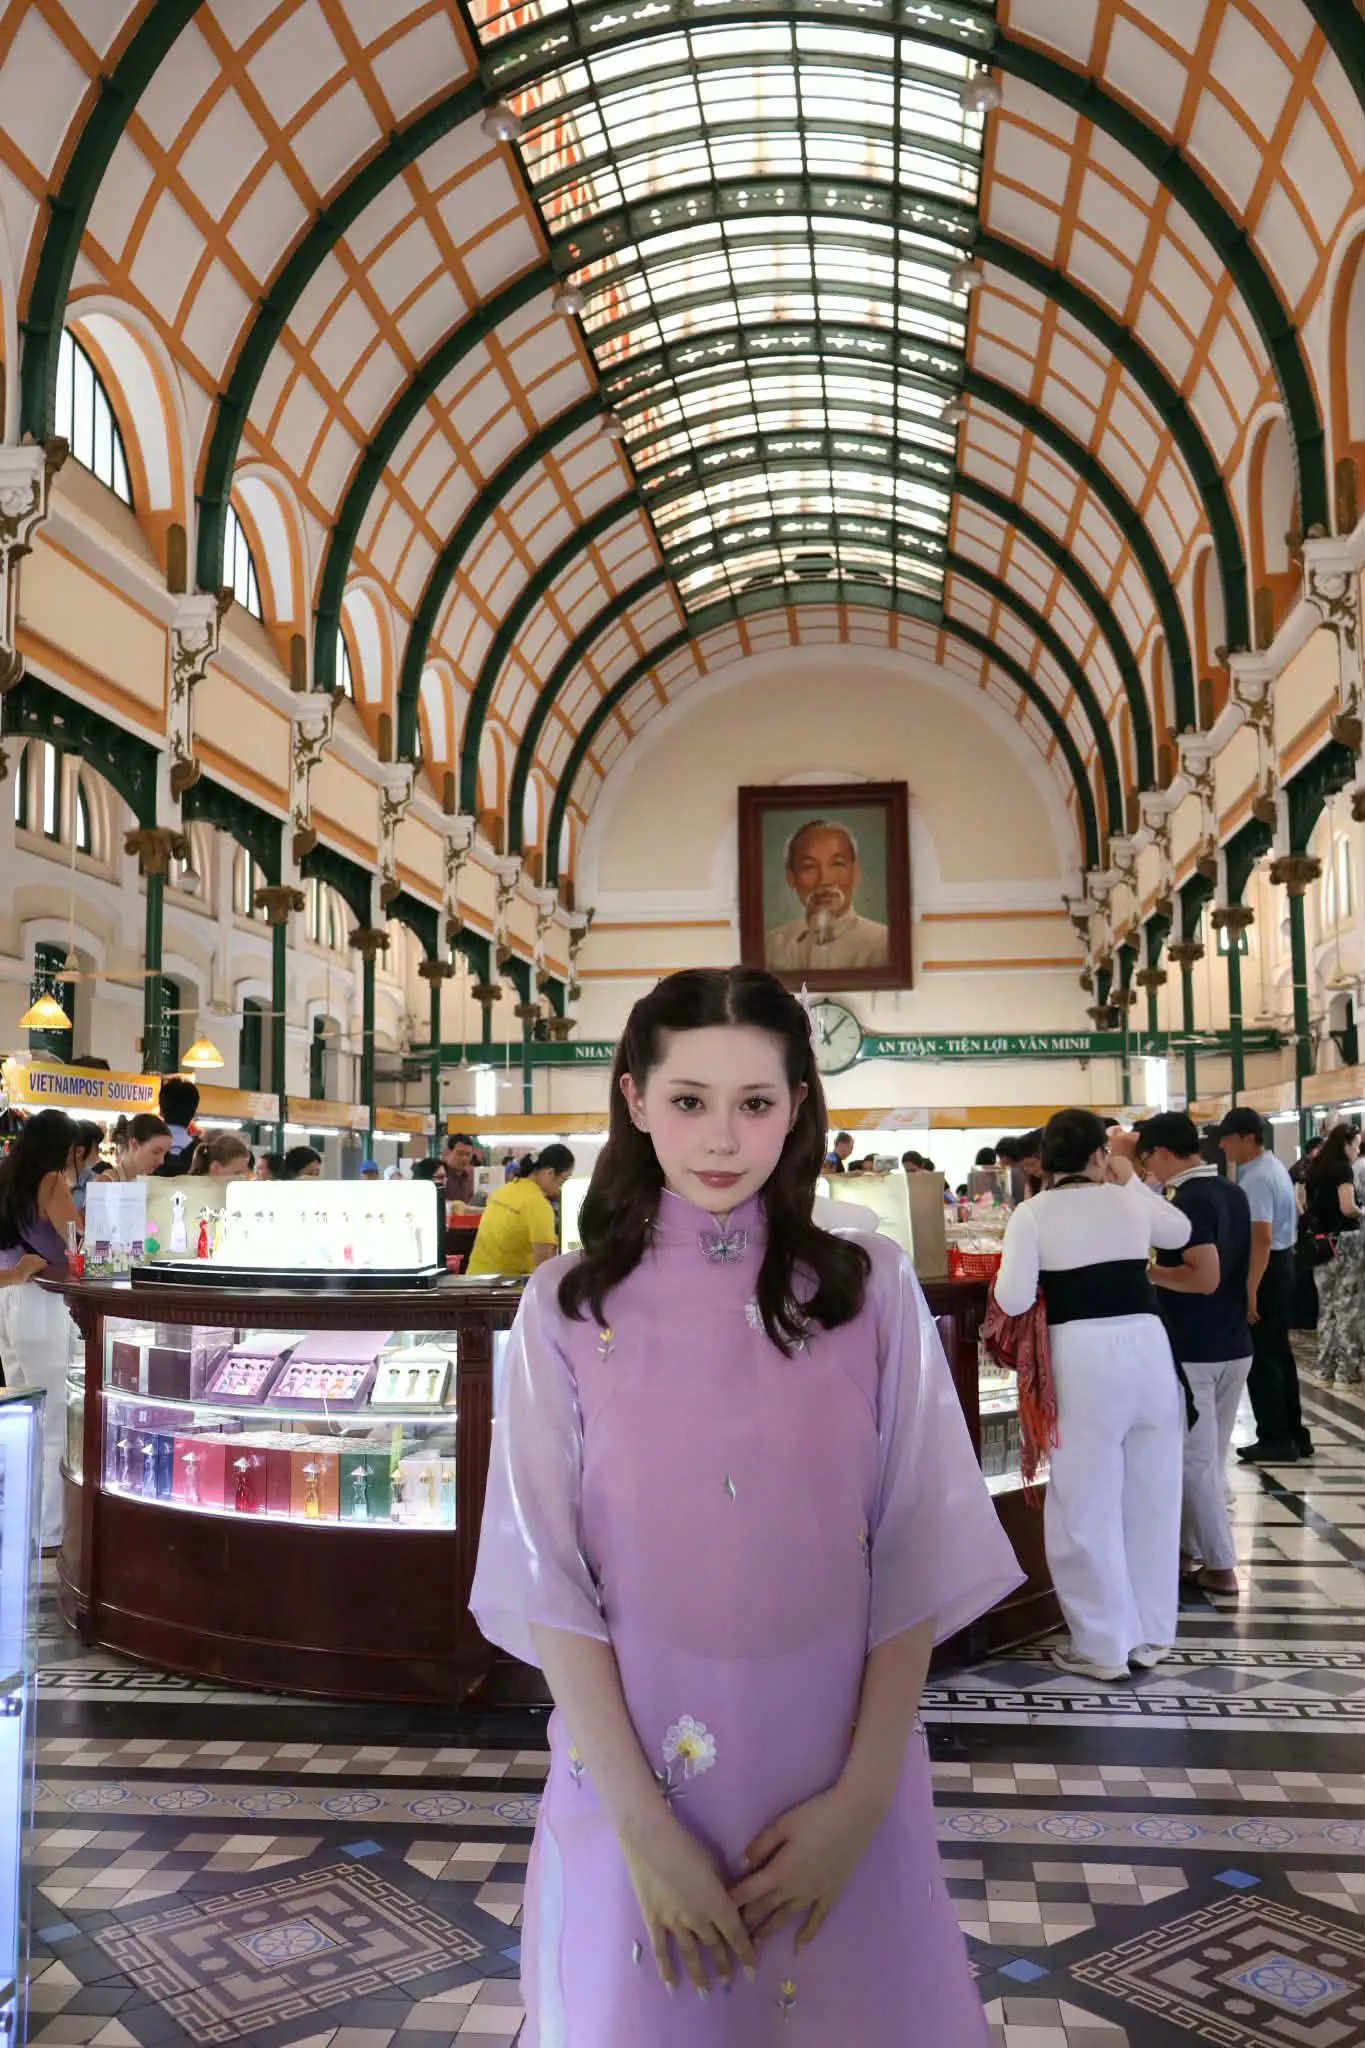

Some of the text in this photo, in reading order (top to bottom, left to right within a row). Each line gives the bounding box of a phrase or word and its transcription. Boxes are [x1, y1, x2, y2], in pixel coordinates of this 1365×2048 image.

[575, 1046, 616, 1058] NHAN
[877, 1040, 895, 1053] AN
[946, 1036, 980, 1054] TIỆN
[983, 1037, 1008, 1054] LỢI
[1051, 1037, 1090, 1050] MINH
[29, 1072, 153, 1101] VIETNAMPOST SOUVENIR
